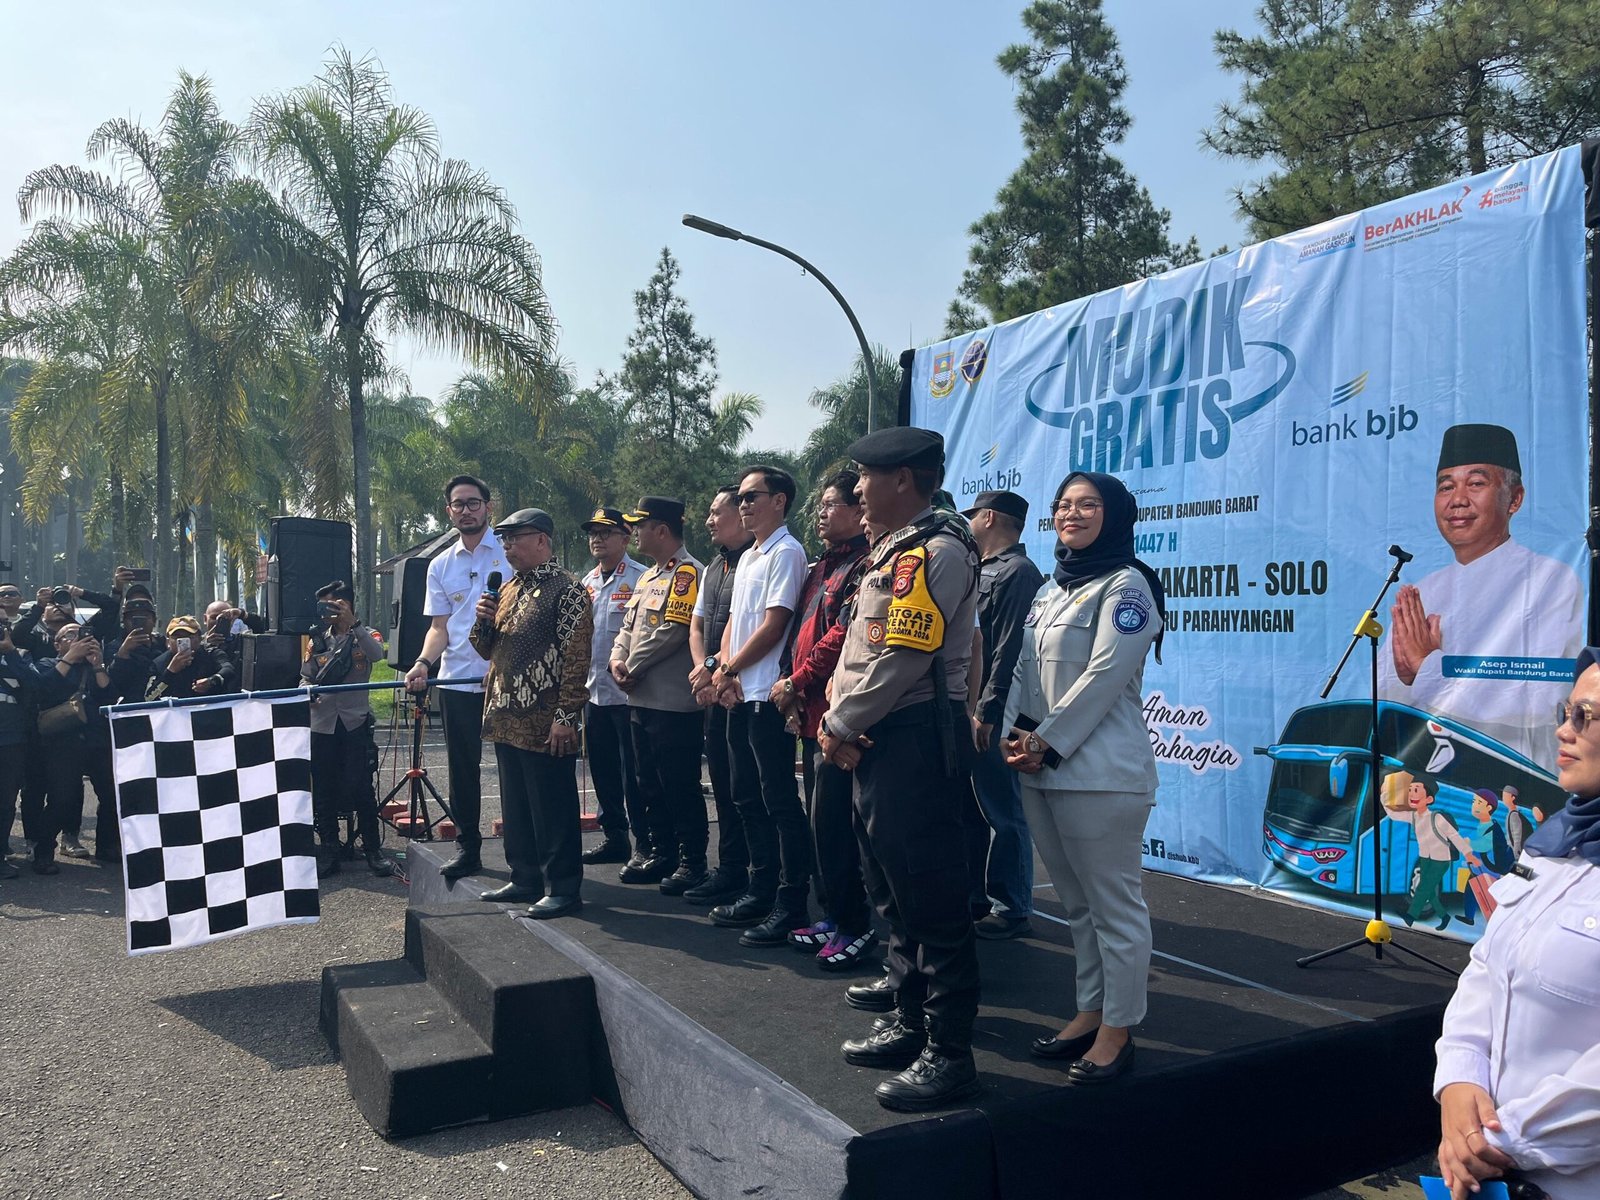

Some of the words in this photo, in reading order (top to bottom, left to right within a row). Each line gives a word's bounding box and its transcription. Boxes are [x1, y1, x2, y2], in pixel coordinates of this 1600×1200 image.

[1364, 199, 1463, 241] BerAKHLAK
[1064, 275, 1251, 408] MUDIK
[1069, 378, 1233, 474] GRATIS
[1292, 413, 1358, 447] bank
[1366, 404, 1418, 440] bjb
[961, 472, 993, 495] bank
[996, 468, 1021, 491] bjb
[1176, 499, 1222, 518] BANDUNG
[1224, 495, 1259, 512] BARAT
[1134, 532, 1164, 554] 1447
[1169, 532, 1177, 552] H
[1265, 560, 1328, 597] SOLO
[1183, 609, 1294, 633] PARAHYANGAN
[1477, 668, 1505, 676] Bupati
[1507, 669, 1547, 677] Bandung
[1480, 660, 1507, 669] Asep
[1510, 661, 1545, 669] Ismail
[1142, 695, 1207, 727] Aman
